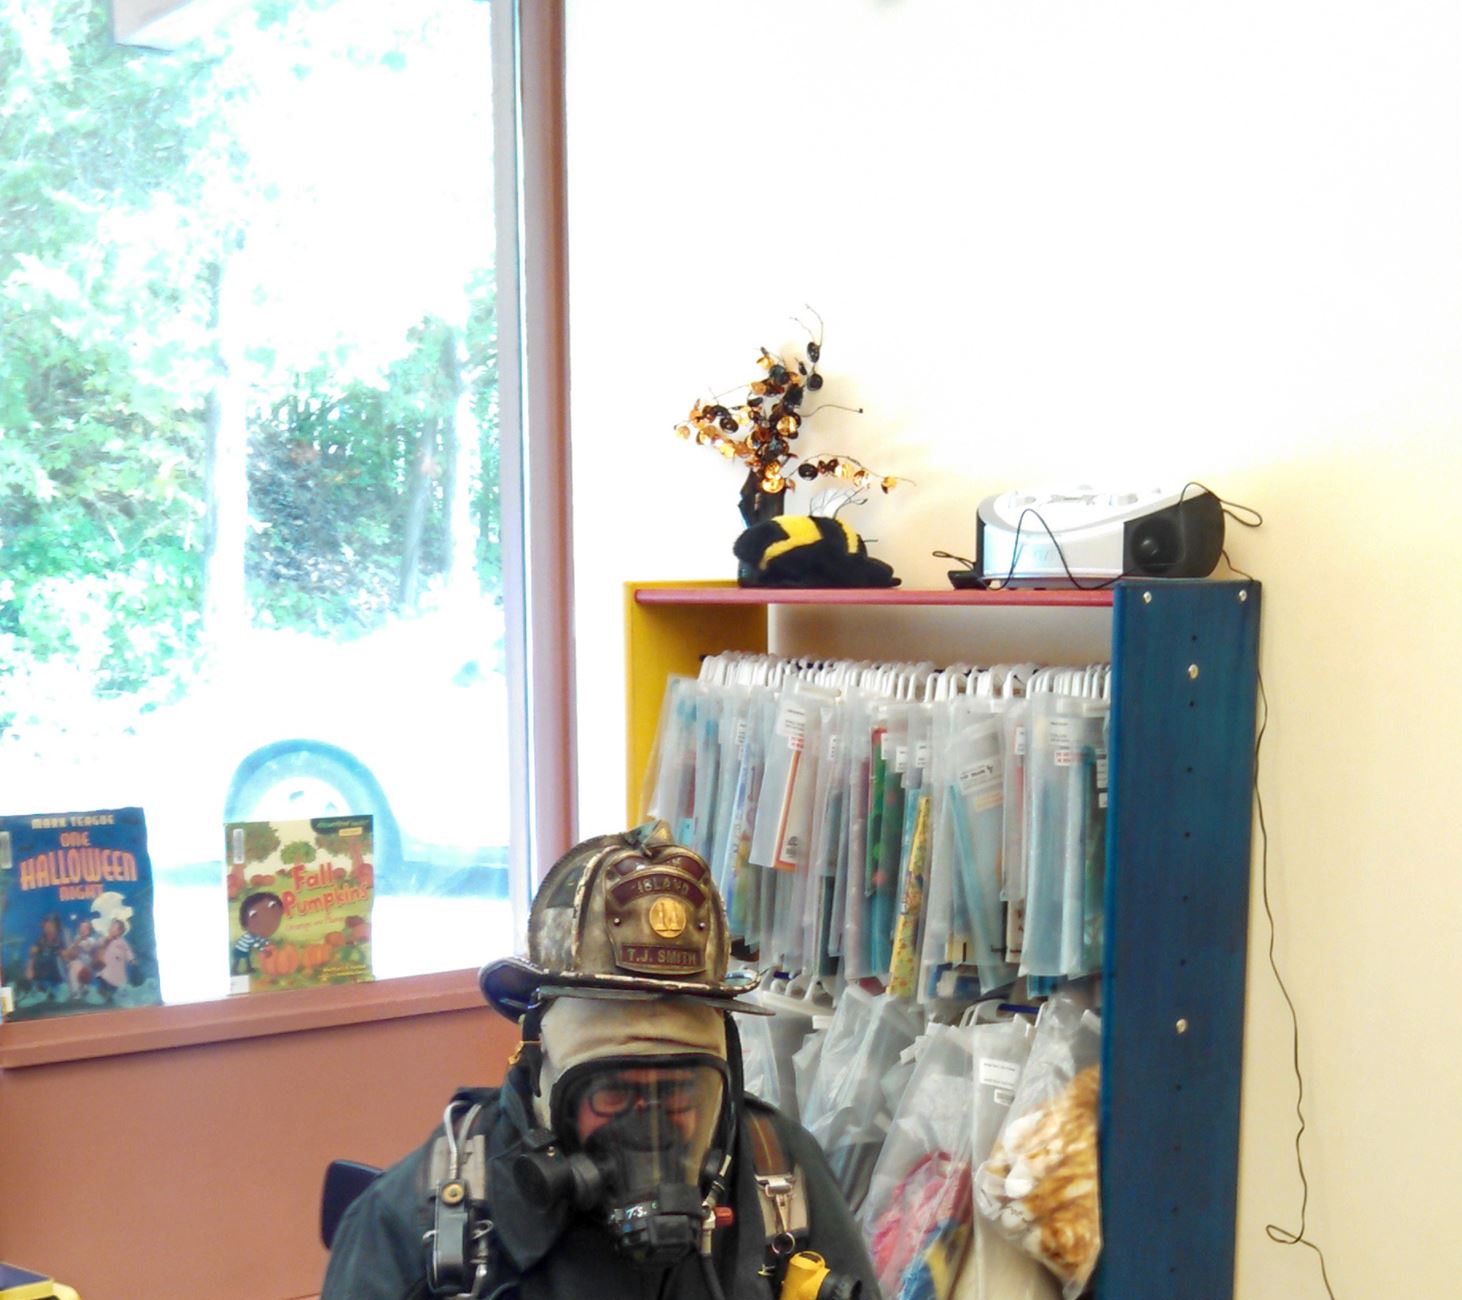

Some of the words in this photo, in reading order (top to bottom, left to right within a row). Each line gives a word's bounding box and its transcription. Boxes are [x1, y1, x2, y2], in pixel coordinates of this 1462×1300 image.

[61, 831, 90, 847] ONE
[20, 847, 137, 891] HALLOWEEN
[292, 863, 333, 893] Fall
[282, 883, 369, 918] Pumpkins
[628, 949, 654, 963] T.J.
[659, 951, 697, 966] SMITH
